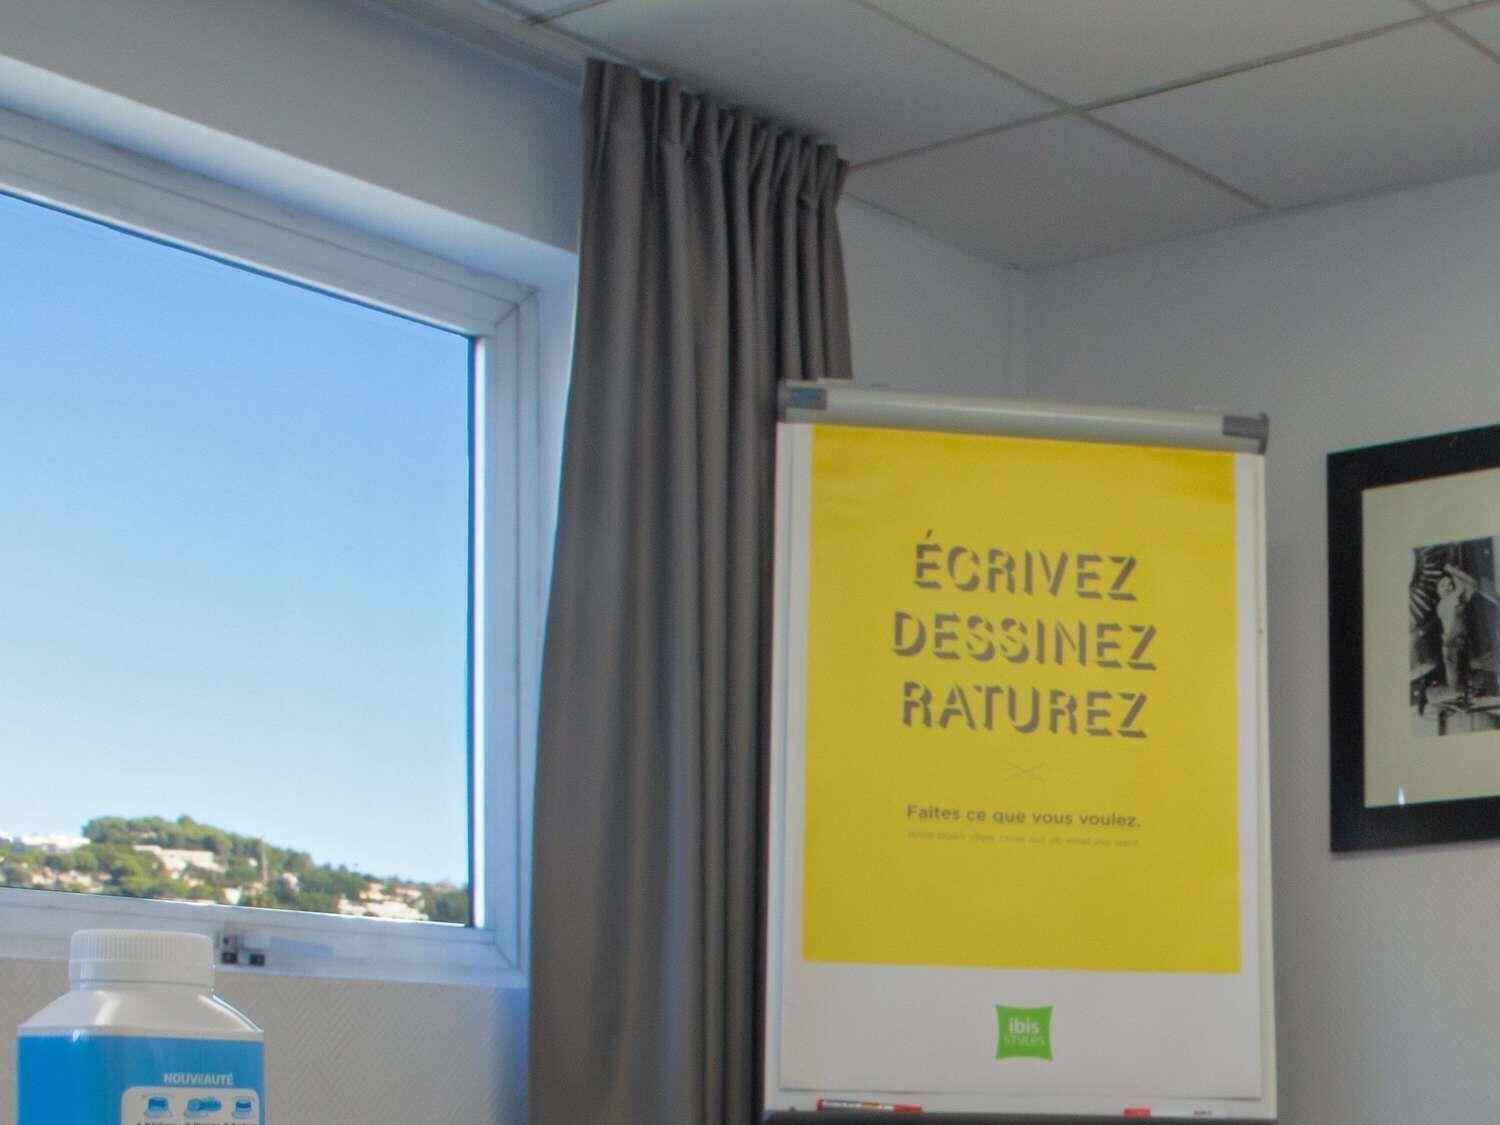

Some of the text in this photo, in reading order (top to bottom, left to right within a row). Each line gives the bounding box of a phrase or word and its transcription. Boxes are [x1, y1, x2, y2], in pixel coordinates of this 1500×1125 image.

[914, 528, 1138, 603] ÉCRIVEZ
[892, 610, 1158, 672] DESSINEZ
[901, 680, 1148, 740] RATUREZ
[906, 804, 1142, 829] Faites ce que vous voulez.
[1008, 1016, 1041, 1035] ibis
[163, 1071, 235, 1087] NOUVEAUTÉ
